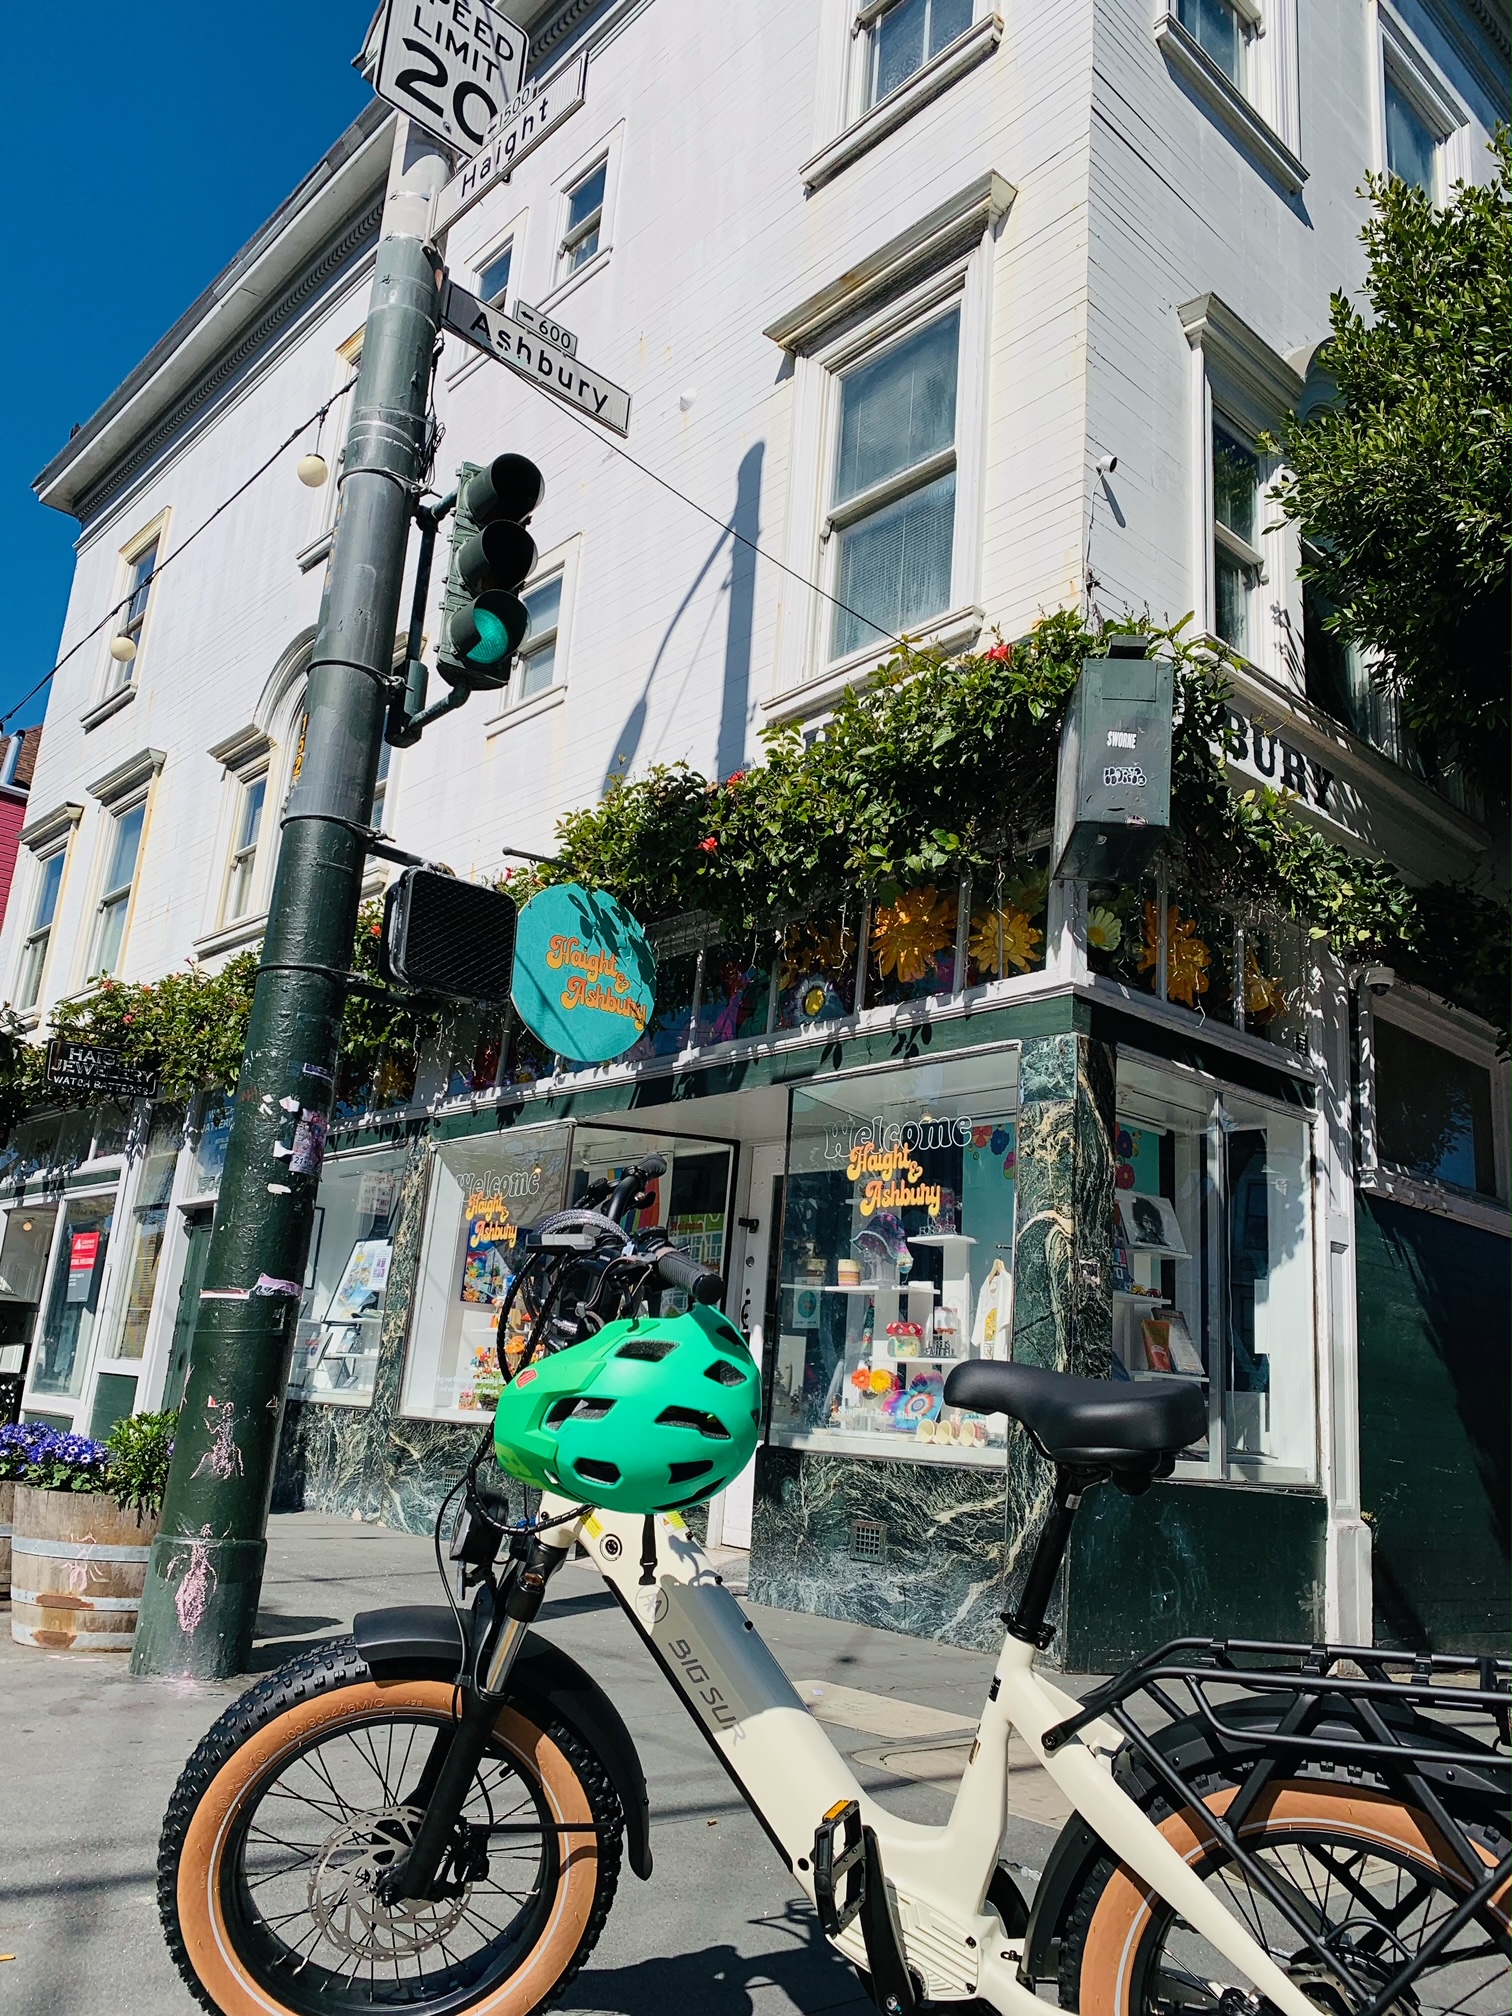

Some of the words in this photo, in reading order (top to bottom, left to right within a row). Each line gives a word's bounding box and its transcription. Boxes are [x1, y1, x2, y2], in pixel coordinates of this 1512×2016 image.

[413, 5, 500, 83] LIMIT
[429, 0, 514, 62] EED
[394, 37, 498, 146] 20
[499, 87, 530, 128] 1500
[460, 98, 548, 198] Haight
[538, 320, 571, 350] 600
[469, 312, 608, 414] Ashbury
[545, 934, 617, 983] Haight
[614, 972, 630, 994] &
[560, 976, 648, 1031] Ashbury
[53, 1075, 90, 1089] WATCH
[823, 1115, 973, 1159] Welcome
[846, 1141, 911, 1181] Haight
[907, 1160, 924, 1184] &
[455, 1170, 541, 1202] Welcome
[465, 1190, 504, 1222] Haight
[500, 1205, 510, 1223] &
[859, 1179, 942, 1217] Ashbury
[470, 1220, 518, 1248] Ashbury
[668, 1639, 710, 1684] BIG
[699, 1687, 746, 1747] SUR
